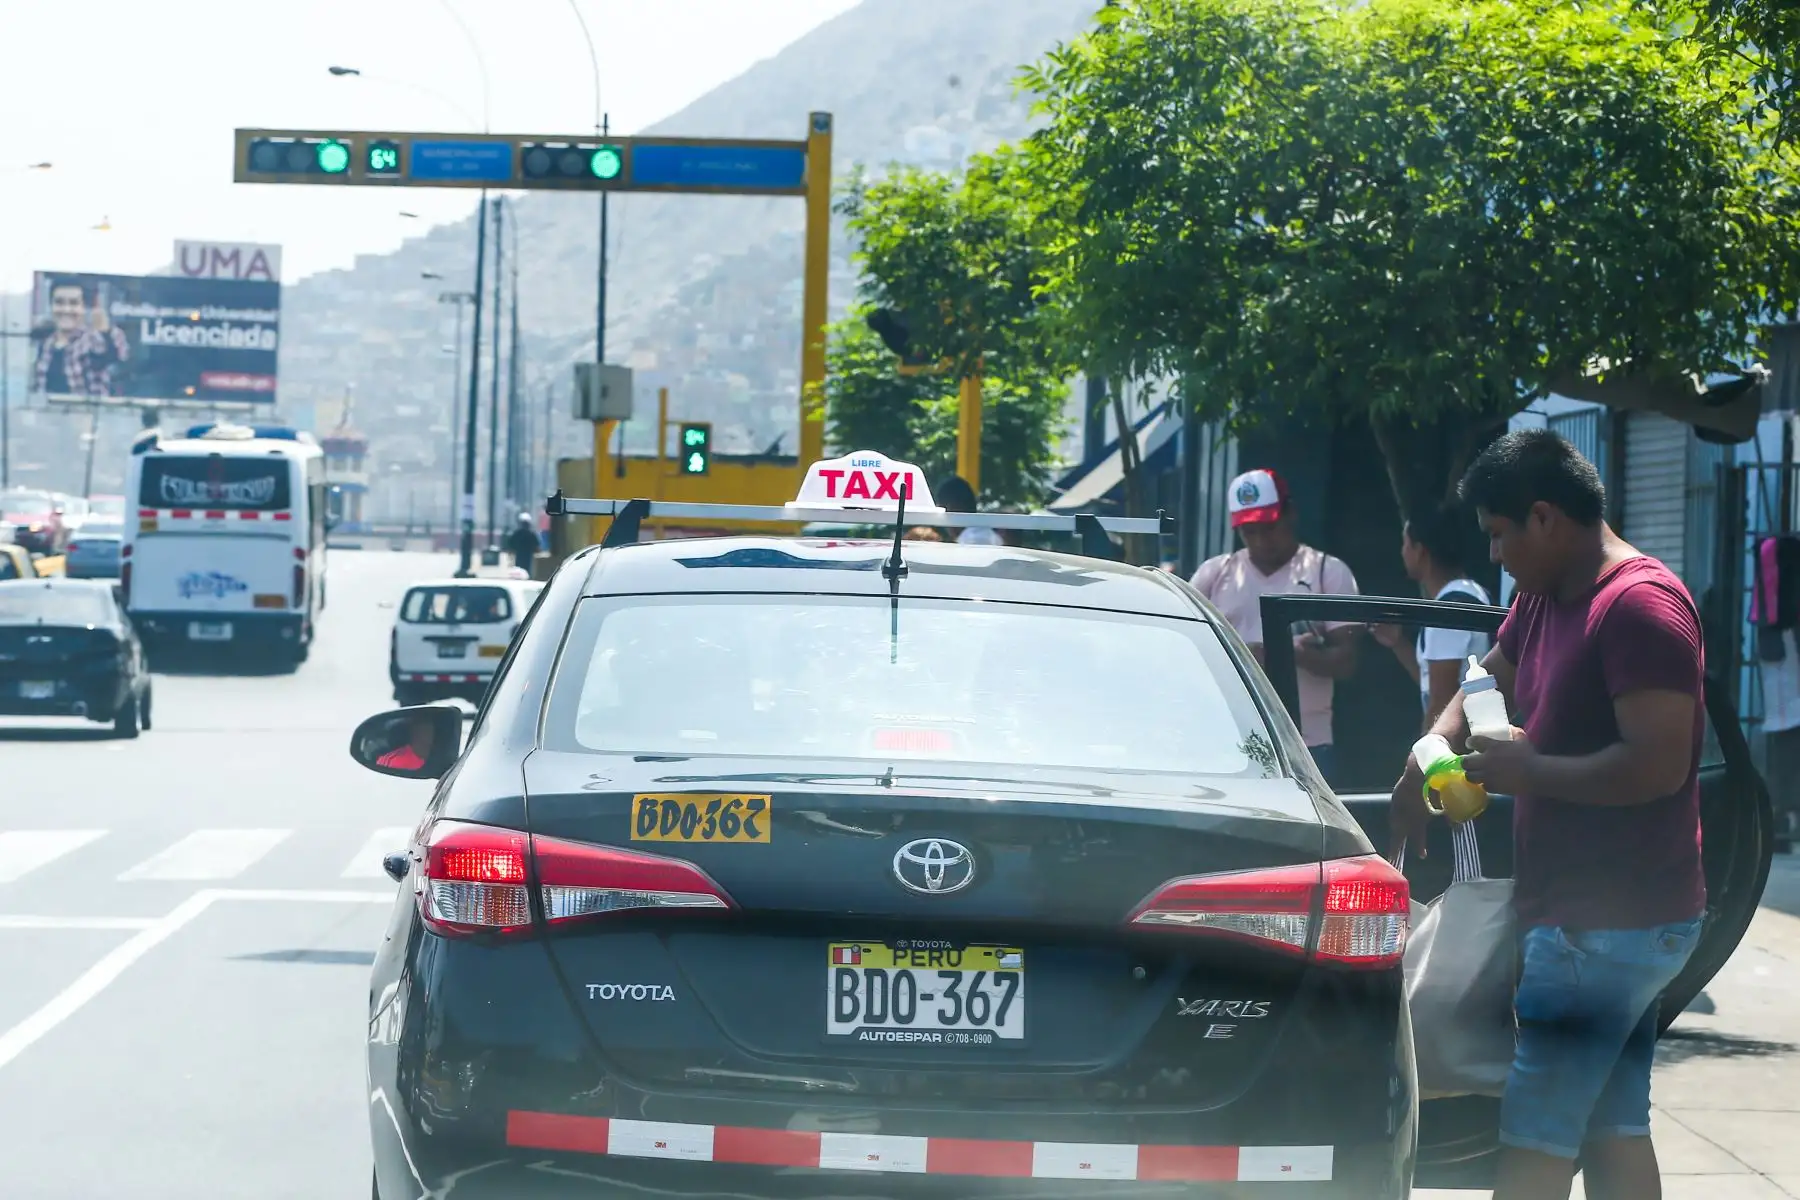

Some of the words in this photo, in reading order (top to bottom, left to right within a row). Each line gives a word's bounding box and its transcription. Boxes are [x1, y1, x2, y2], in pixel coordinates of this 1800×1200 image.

[371, 149, 396, 169] 64
[180, 245, 273, 279] UMA
[140, 318, 277, 350] Licenciada
[851, 459, 882, 468] LIBRE
[818, 469, 914, 501] TAXI
[911, 940, 952, 949] TOYOTA
[893, 948, 963, 968] PERU
[585, 984, 676, 1001] TOYOTA
[858, 1031, 942, 1043] AUTOESPAR
[1203, 1023, 1238, 1039] E
[654, 1141, 667, 1149] 3M
